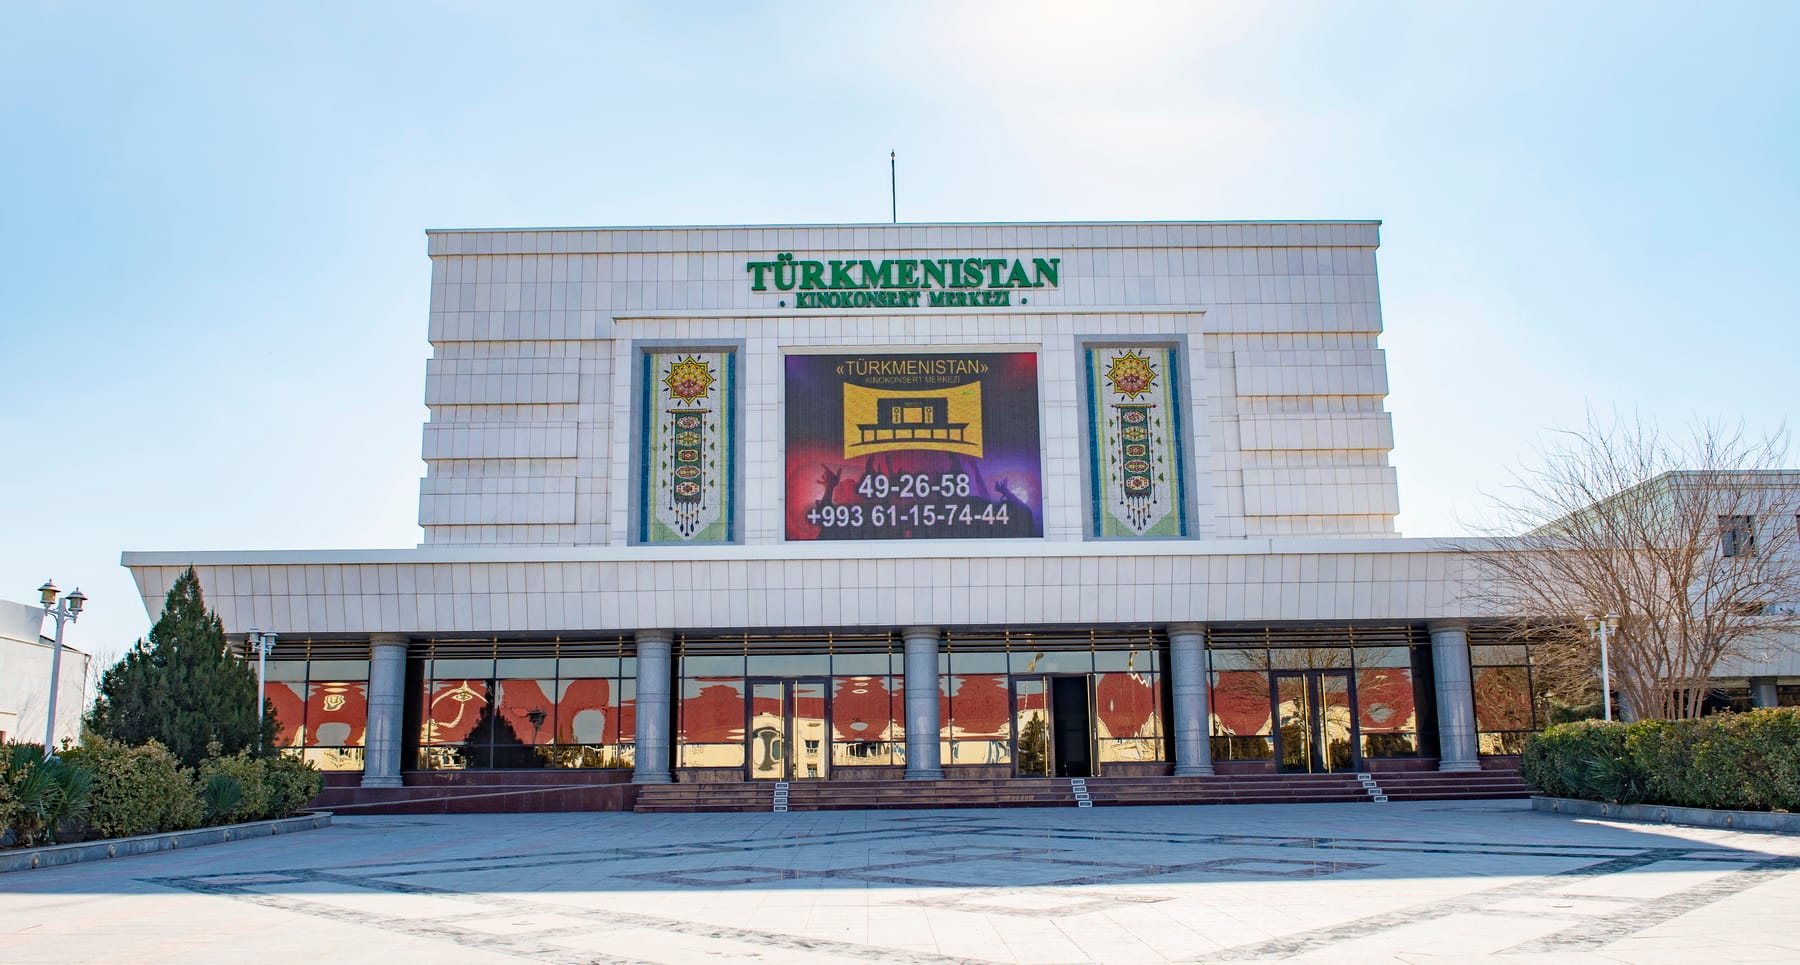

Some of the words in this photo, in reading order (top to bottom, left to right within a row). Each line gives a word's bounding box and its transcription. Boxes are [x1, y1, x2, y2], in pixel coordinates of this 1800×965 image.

[747, 253, 1060, 291] TÜRKMENISTAN
[795, 291, 921, 309] KINOKONSERT
[927, 290, 1011, 308] MERKEZI
[836, 358, 989, 376] «TÜRKMENISTAN»
[864, 375, 923, 384] KINOKONSERT
[924, 375, 960, 384] MERKEZI
[858, 473, 970, 499] 49-26-58
[807, 505, 864, 528] +993
[871, 503, 1010, 527] 61-15-74-44
